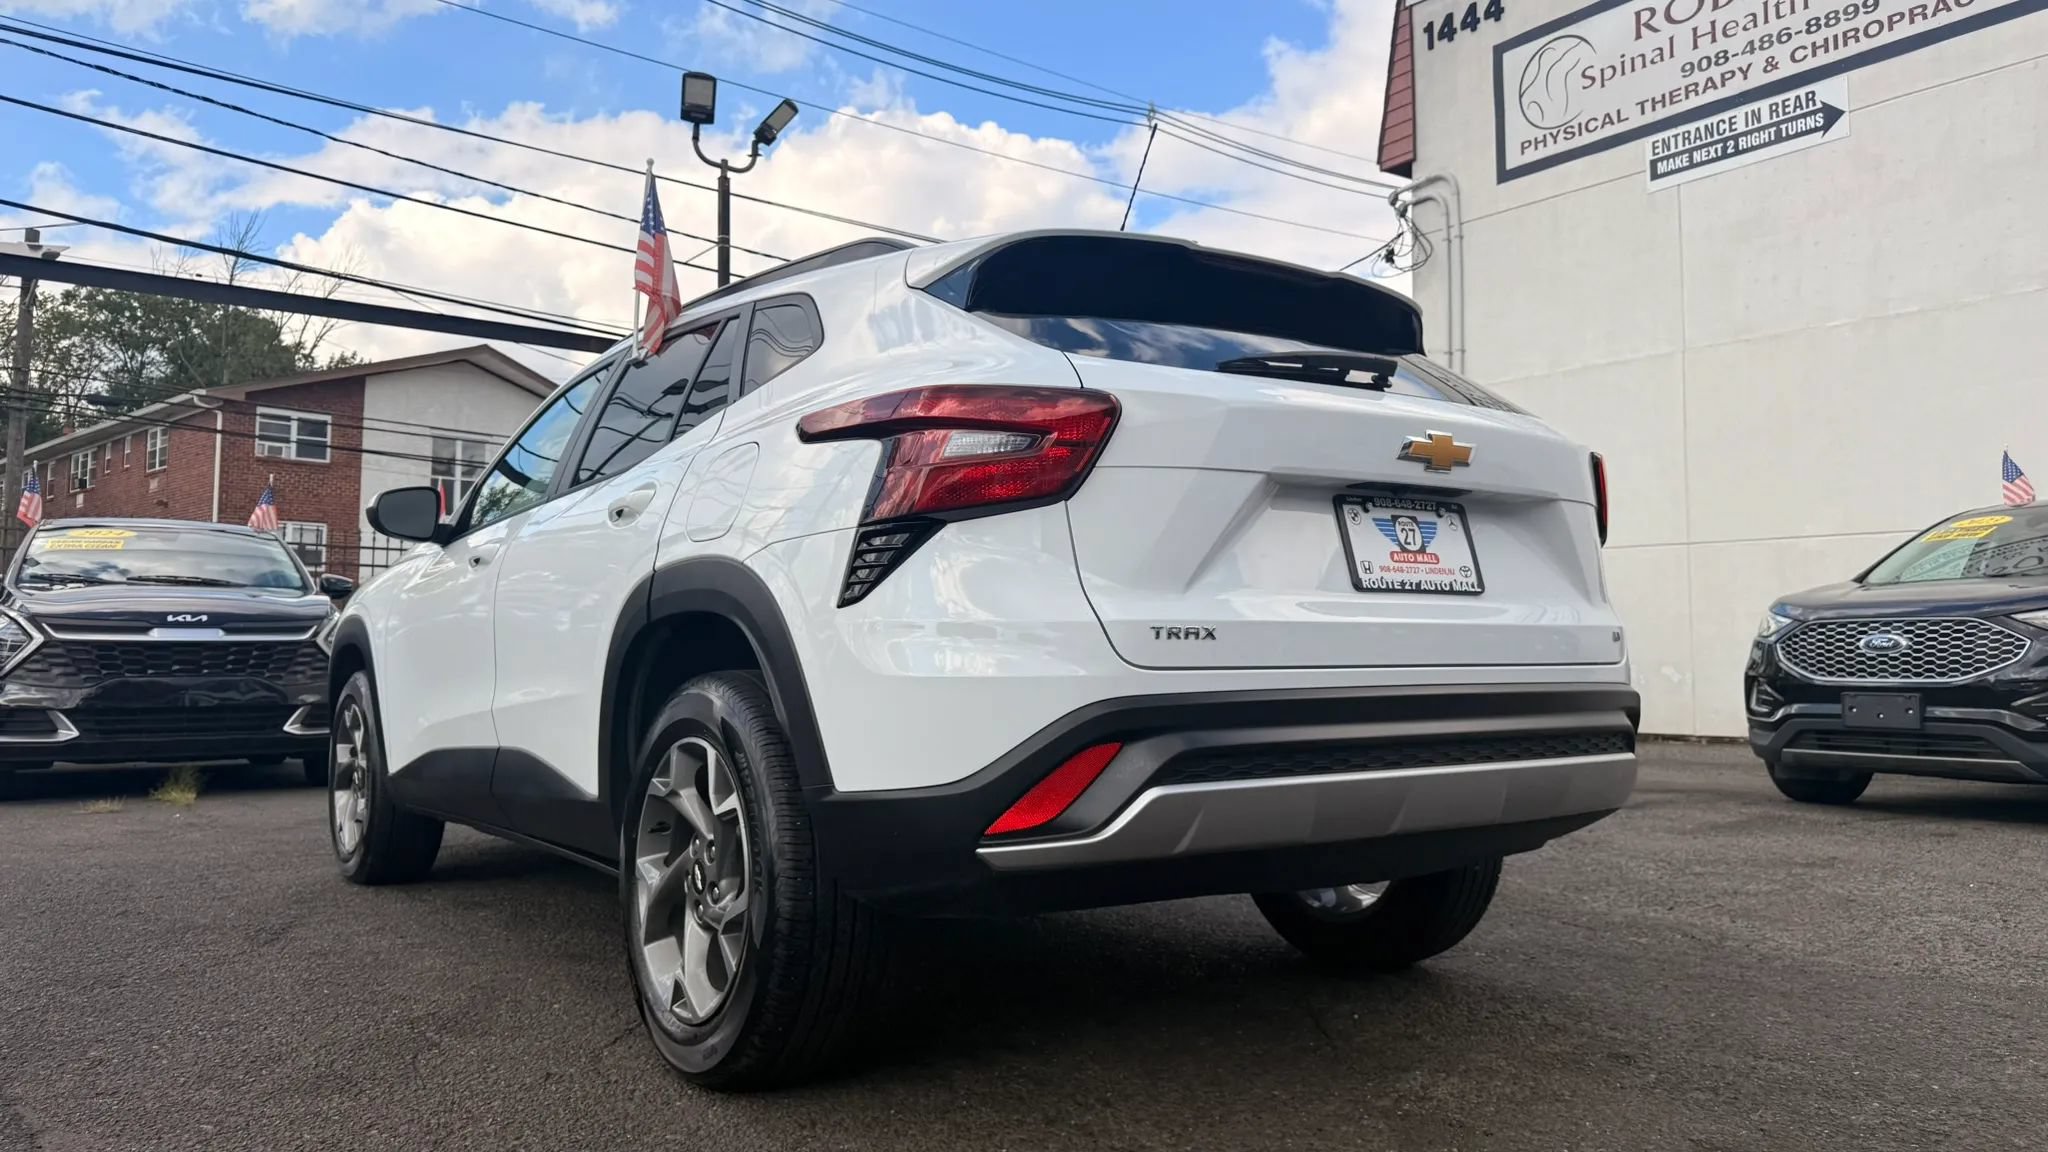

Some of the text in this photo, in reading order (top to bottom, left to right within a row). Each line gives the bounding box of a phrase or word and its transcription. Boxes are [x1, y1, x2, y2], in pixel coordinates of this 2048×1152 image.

[1423, 0, 1504, 50] 1444
[1680, 0, 1880, 78] 908-486-8899
[1581, 35, 1675, 90] Spinal
[1520, 109, 1629, 155] PHYSICAL
[1635, 63, 1753, 116] THERAPY
[1762, 55, 1780, 74] &
[1651, 89, 1818, 157] ENTRANCE IN REAR
[1656, 112, 1825, 175] MAKE NEXT 2 RIGHT TURNS
[1393, 552, 1438, 563] AUTO MALL
[1400, 527, 1417, 546] 27
[1362, 578, 1482, 592] ROUTE 27 AUTO MALL
[1149, 626, 1217, 640] TRAX
